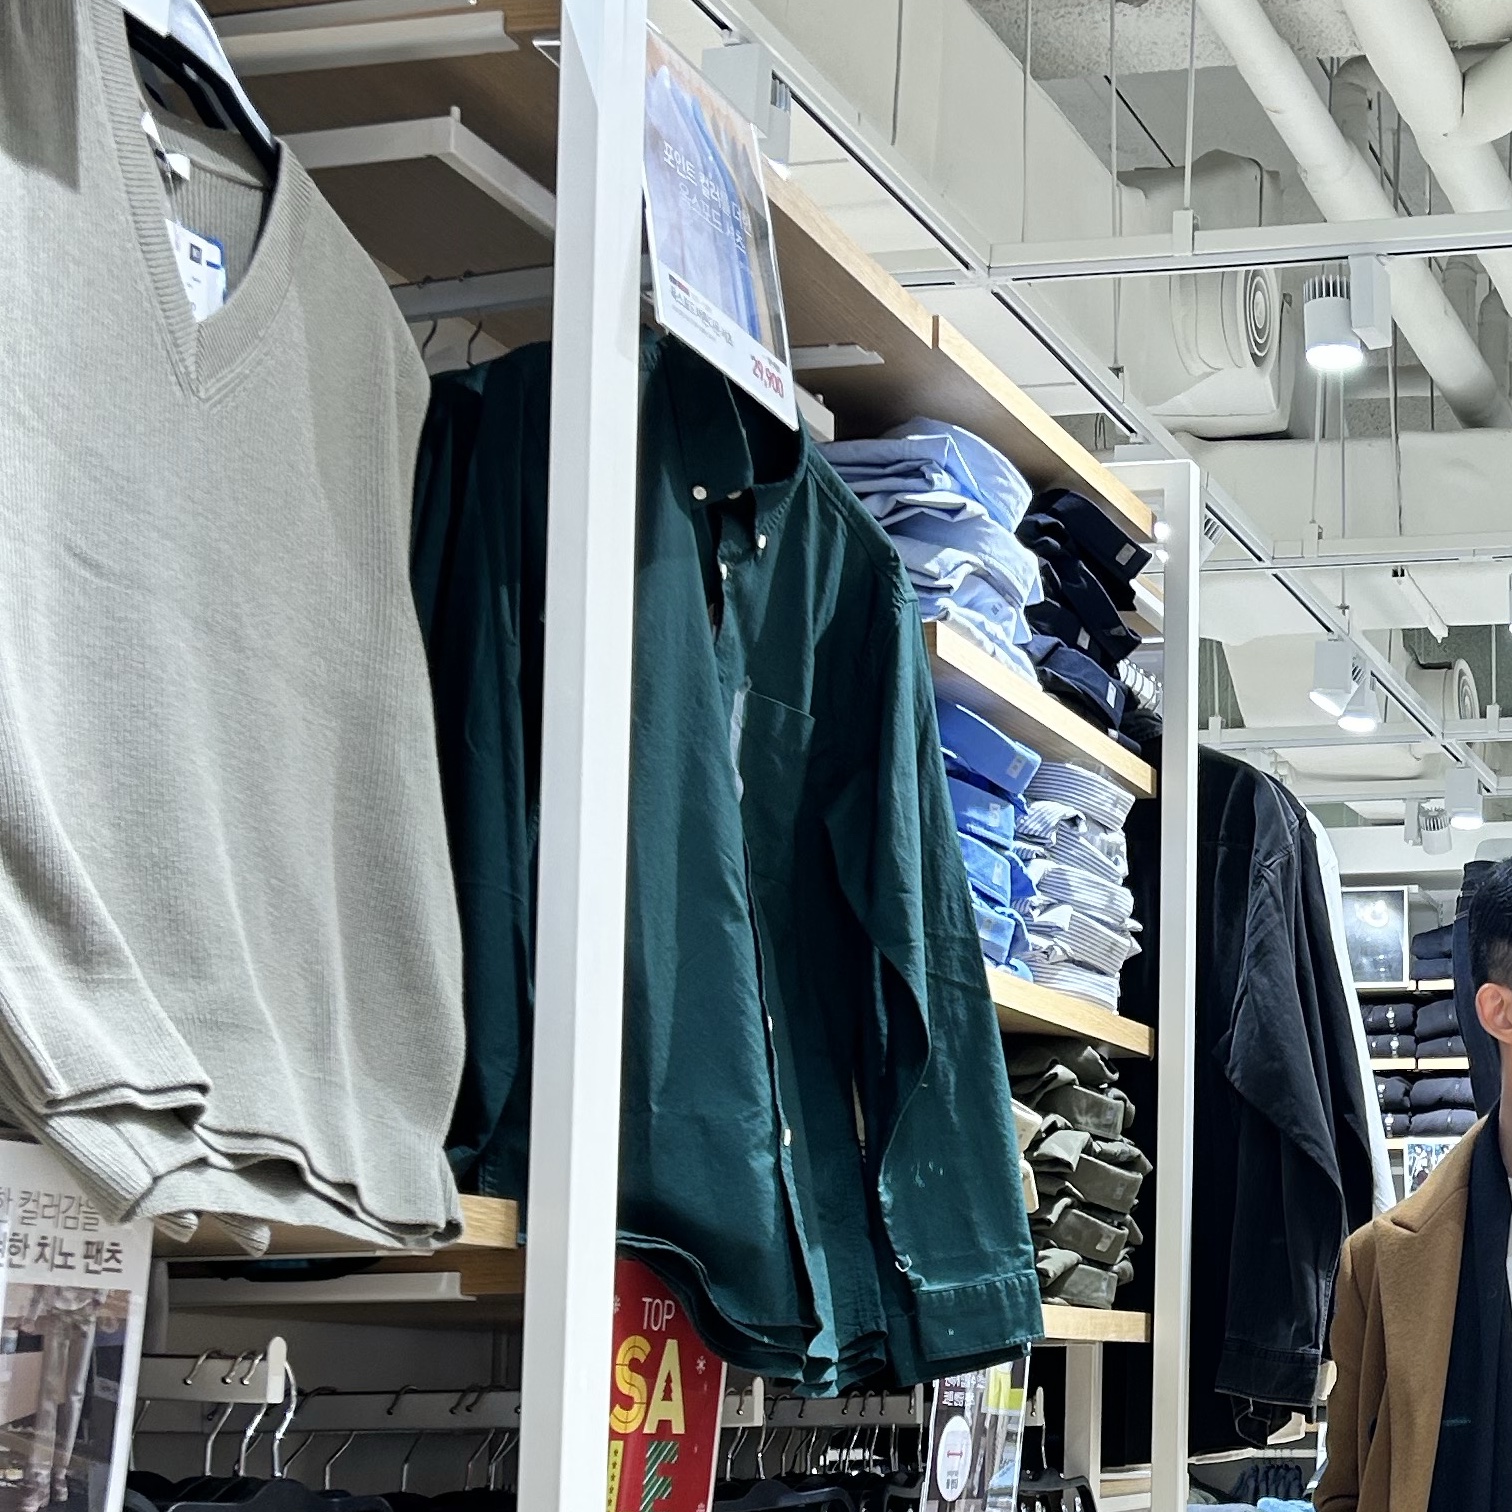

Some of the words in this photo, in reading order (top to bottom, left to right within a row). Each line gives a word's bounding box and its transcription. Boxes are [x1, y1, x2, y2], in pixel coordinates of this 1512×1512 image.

[19, 1190, 100, 1232] 컬러감을
[34, 1235, 76, 1272] 치노
[83, 1241, 123, 1275] 팬츠
[641, 1297, 676, 1332] TOP
